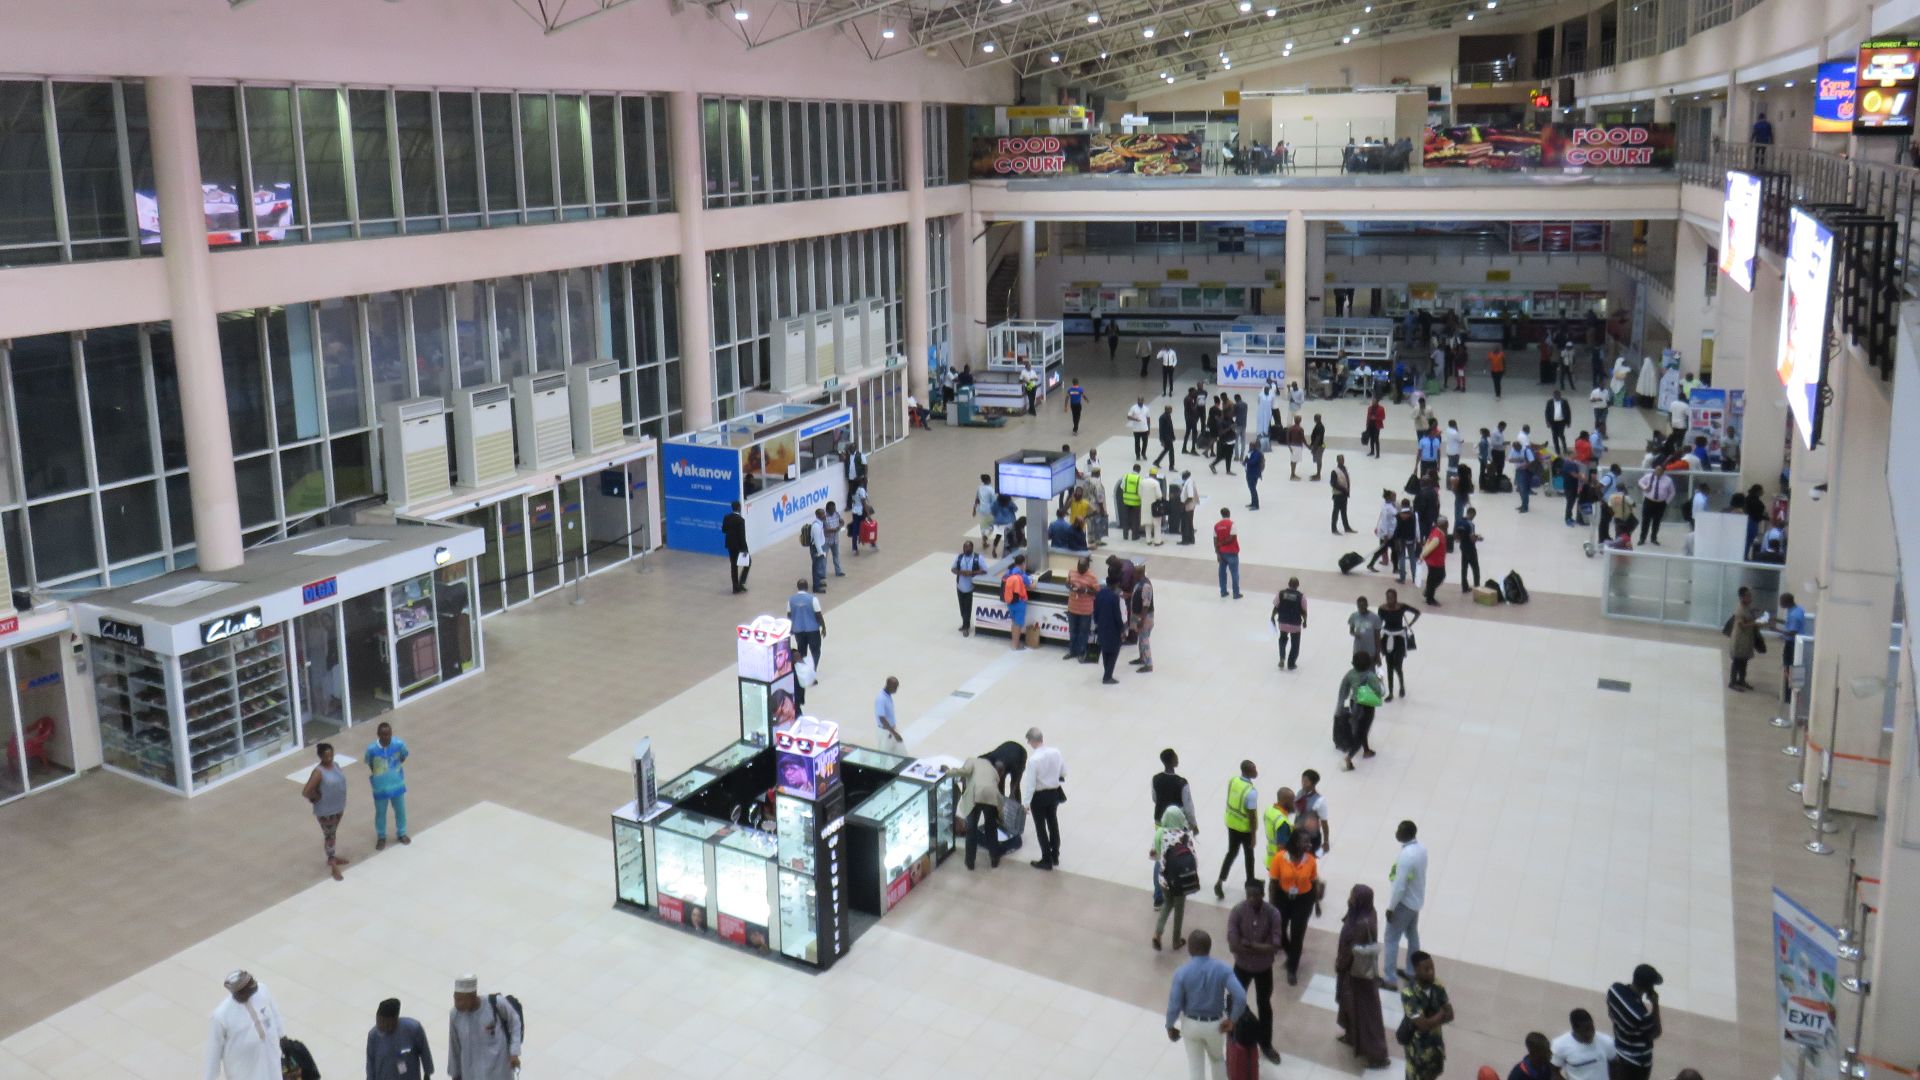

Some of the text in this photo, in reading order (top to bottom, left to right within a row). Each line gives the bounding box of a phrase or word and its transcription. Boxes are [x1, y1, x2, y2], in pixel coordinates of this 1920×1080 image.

[998, 136, 1060, 154] FOOD
[1572, 127, 1648, 145] FOOD
[994, 155, 1065, 173] COURT
[1566, 147, 1654, 165] COURT
[1223, 361, 1285, 381] Wakano
[671, 460, 732, 480] Wakanow
[772, 485, 829, 523] Wakanow
[0, 620, 15, 631] XIT
[102, 621, 138, 645] Clarks
[206, 612, 262, 643] Clarks
[1788, 1008, 1825, 1030] EXIT
